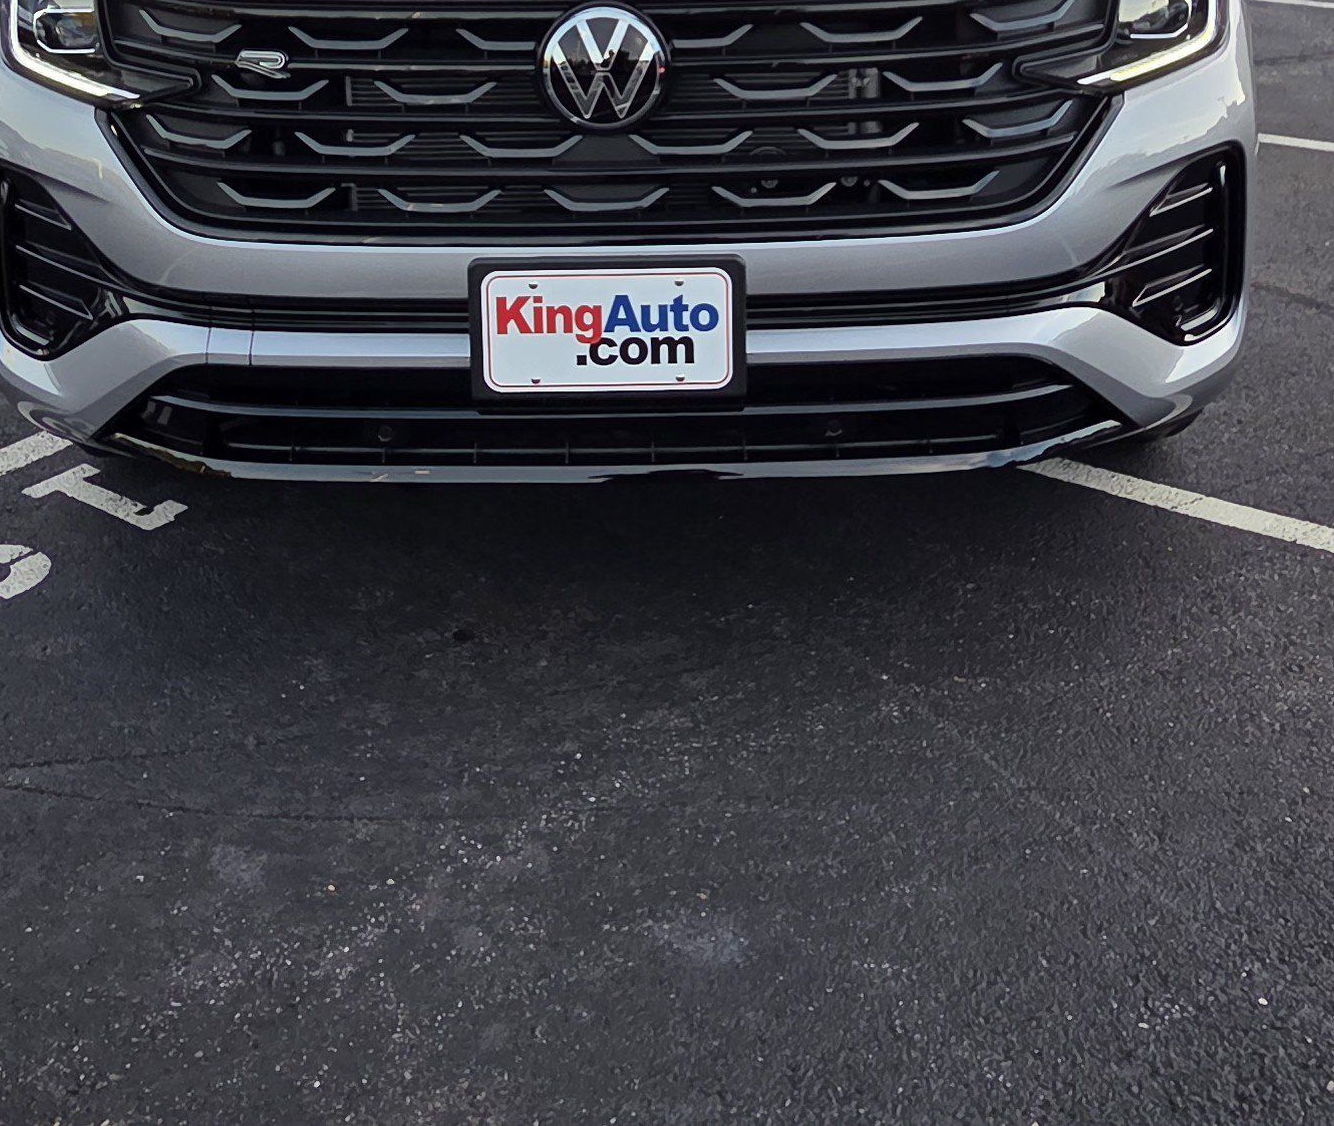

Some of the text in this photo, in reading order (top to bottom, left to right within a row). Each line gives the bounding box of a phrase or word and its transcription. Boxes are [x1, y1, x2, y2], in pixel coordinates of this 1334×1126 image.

[543, 6, 666, 129] VW
[495, 293, 720, 345] KingAuto
[575, 334, 696, 367] .com
